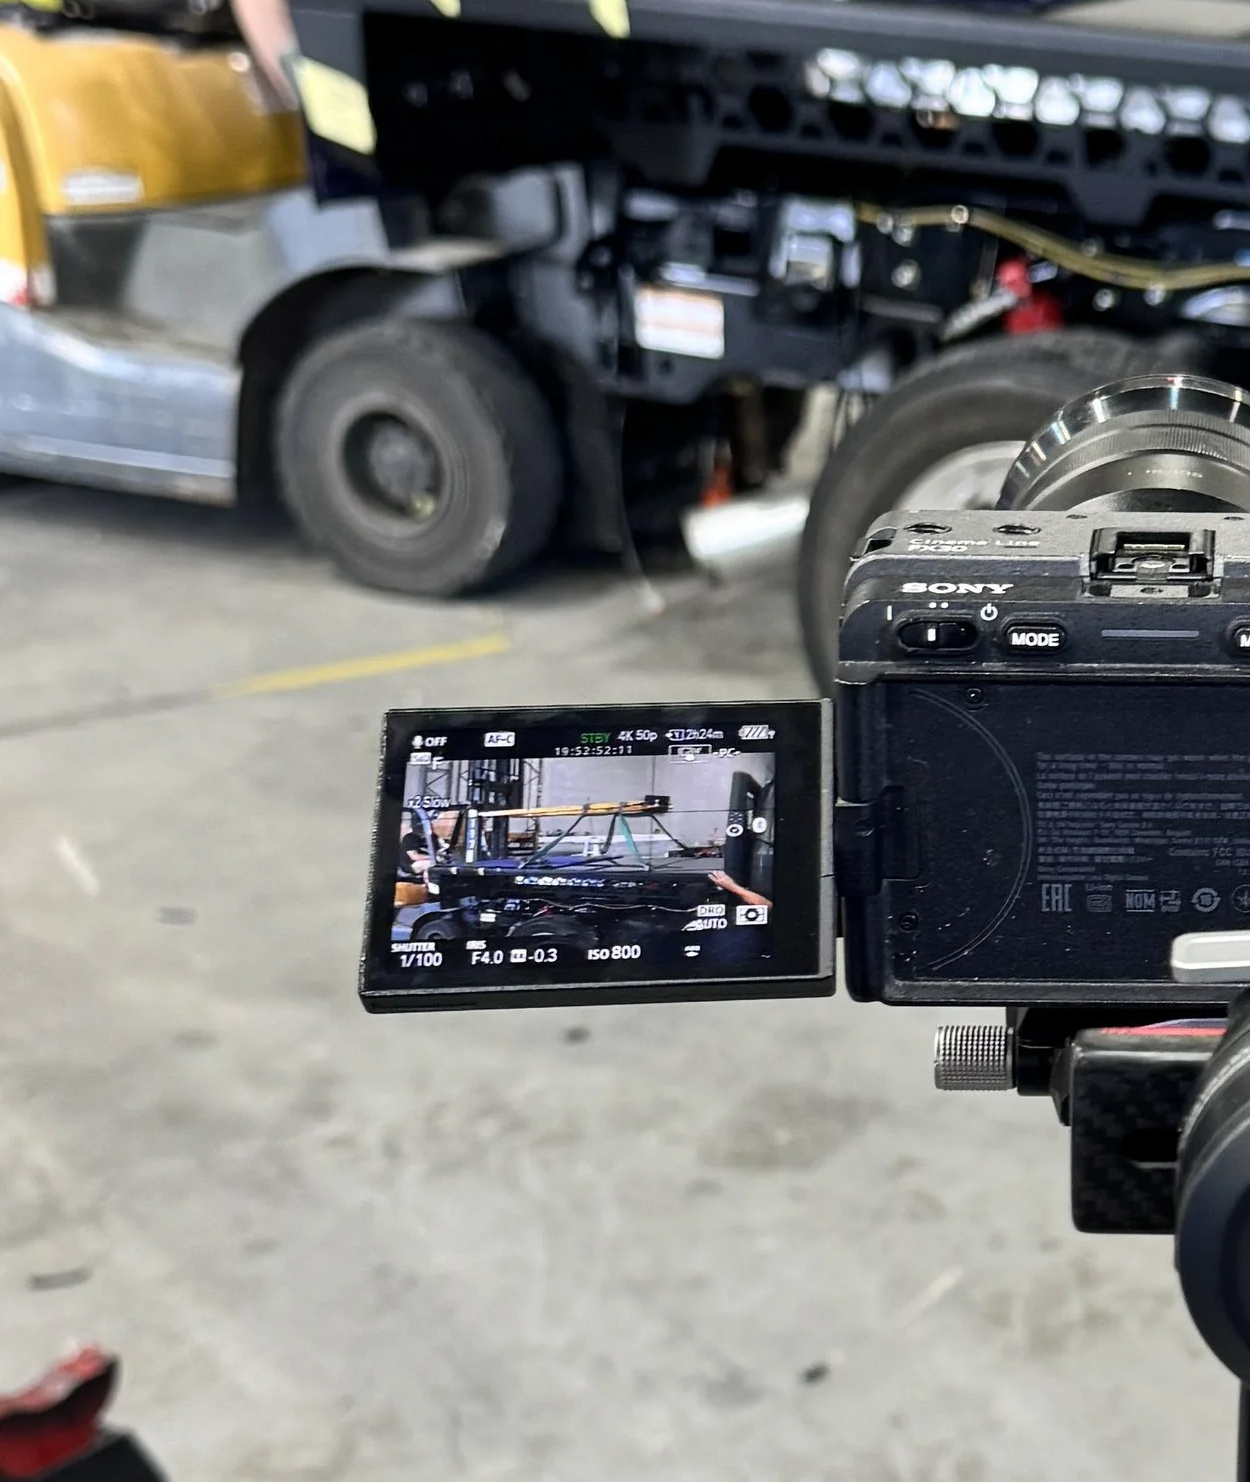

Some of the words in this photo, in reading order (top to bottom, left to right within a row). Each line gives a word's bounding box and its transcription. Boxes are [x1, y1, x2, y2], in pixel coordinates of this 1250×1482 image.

[900, 582, 1015, 595] SONY
[1011, 632, 1060, 647] MODE
[424, 736, 448, 748] OFF
[579, 732, 612, 744] STBY
[617, 730, 634, 742] 4K
[635, 729, 658, 743] 50p
[554, 745, 633, 756] 19:52:52:11
[390, 942, 436, 953] SHUTTER
[611, 945, 642, 960] 800
[400, 952, 443, 968] 1/100
[470, 950, 504, 965] F4.0
[527, 948, 558, 963] -0.3
